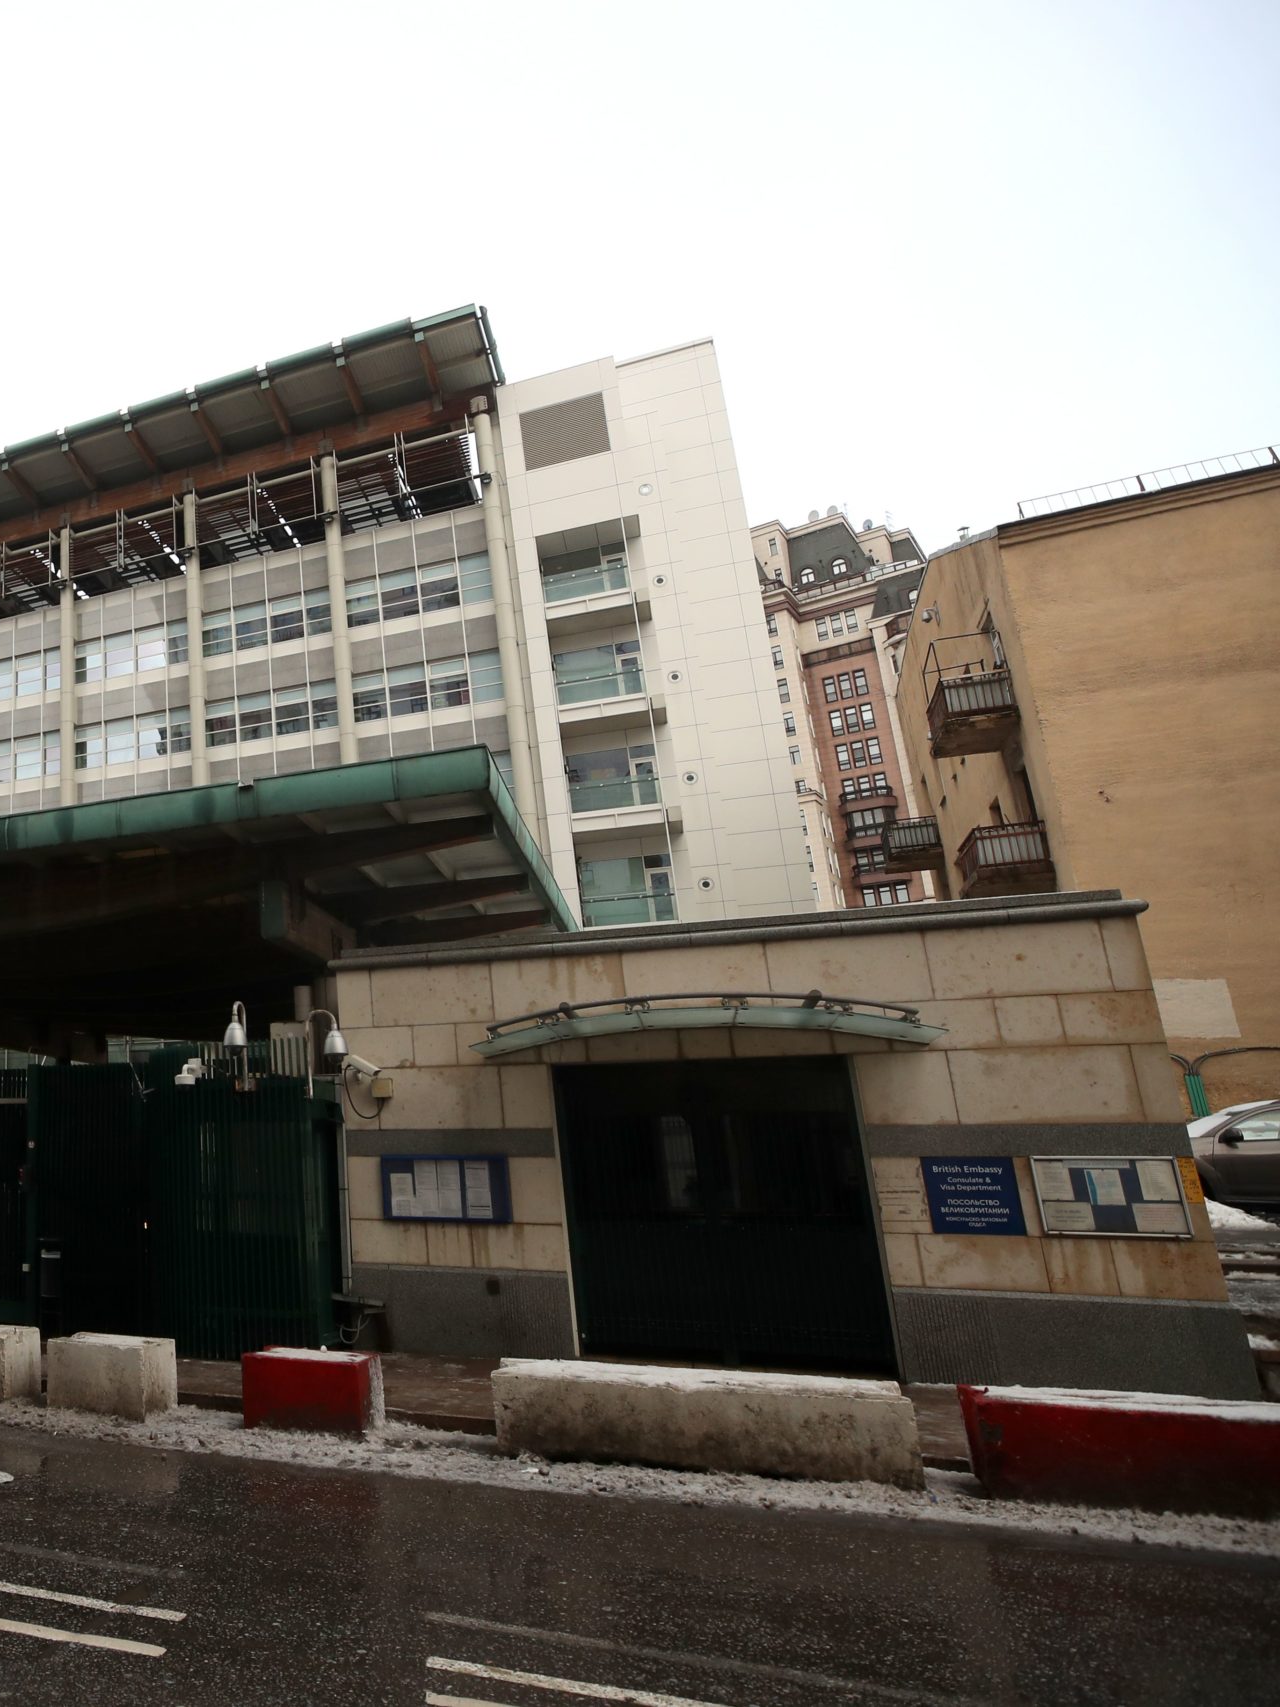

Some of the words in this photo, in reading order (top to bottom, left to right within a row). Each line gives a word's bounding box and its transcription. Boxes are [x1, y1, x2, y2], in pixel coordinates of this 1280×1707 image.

[932, 1165, 961, 1173] British
[963, 1165, 1003, 1175] Embassy
[940, 1206, 1010, 1214] ВЕЛИКОБРИТАНИИ
